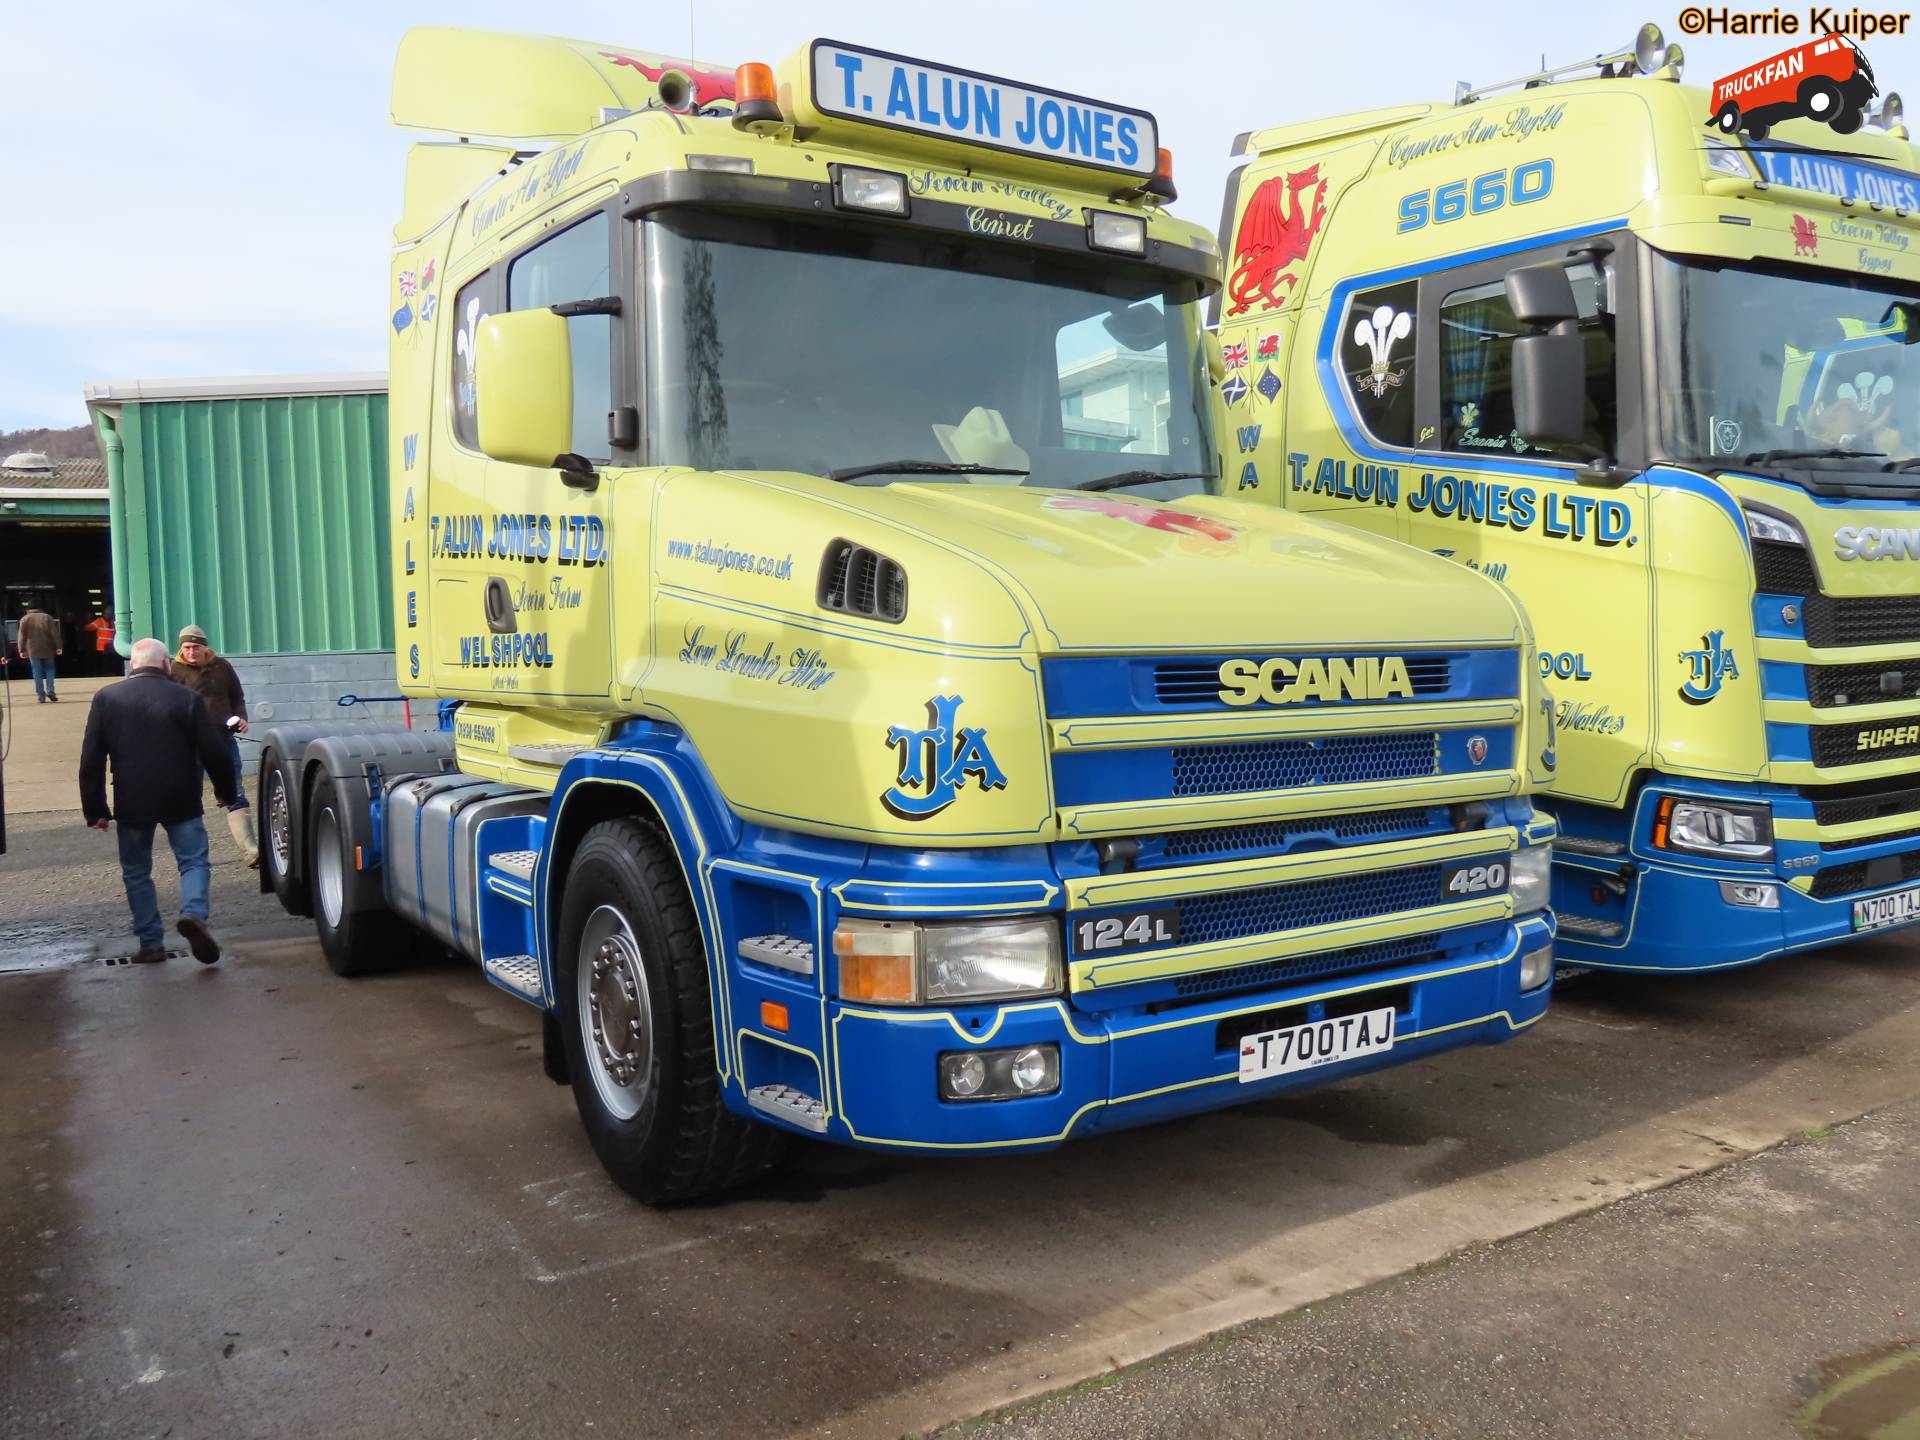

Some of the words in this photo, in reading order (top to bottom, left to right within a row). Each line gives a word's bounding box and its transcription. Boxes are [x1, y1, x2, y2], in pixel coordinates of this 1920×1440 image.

[886, 66, 1000, 138] ALUN
[1016, 96, 1139, 166] JONES
[908, 168, 986, 195] Severn
[1397, 158, 1554, 234] S660
[1790, 160, 1849, 198] ALUN
[1854, 171, 1918, 212] JONES
[1407, 473, 1537, 533] JONES
[1542, 492, 1639, 547] LTD.
[488, 513, 551, 564] JONES
[668, 538, 794, 581] www.talunjones.co.uk
[461, 632, 554, 669] WELSHPOOL
[1217, 657, 1414, 706] SCANIA
[1857, 725, 1919, 751] SUPER
[1450, 864, 1506, 894] 420
[1783, 855, 1820, 869] S660
[1862, 896, 1895, 923] N700
